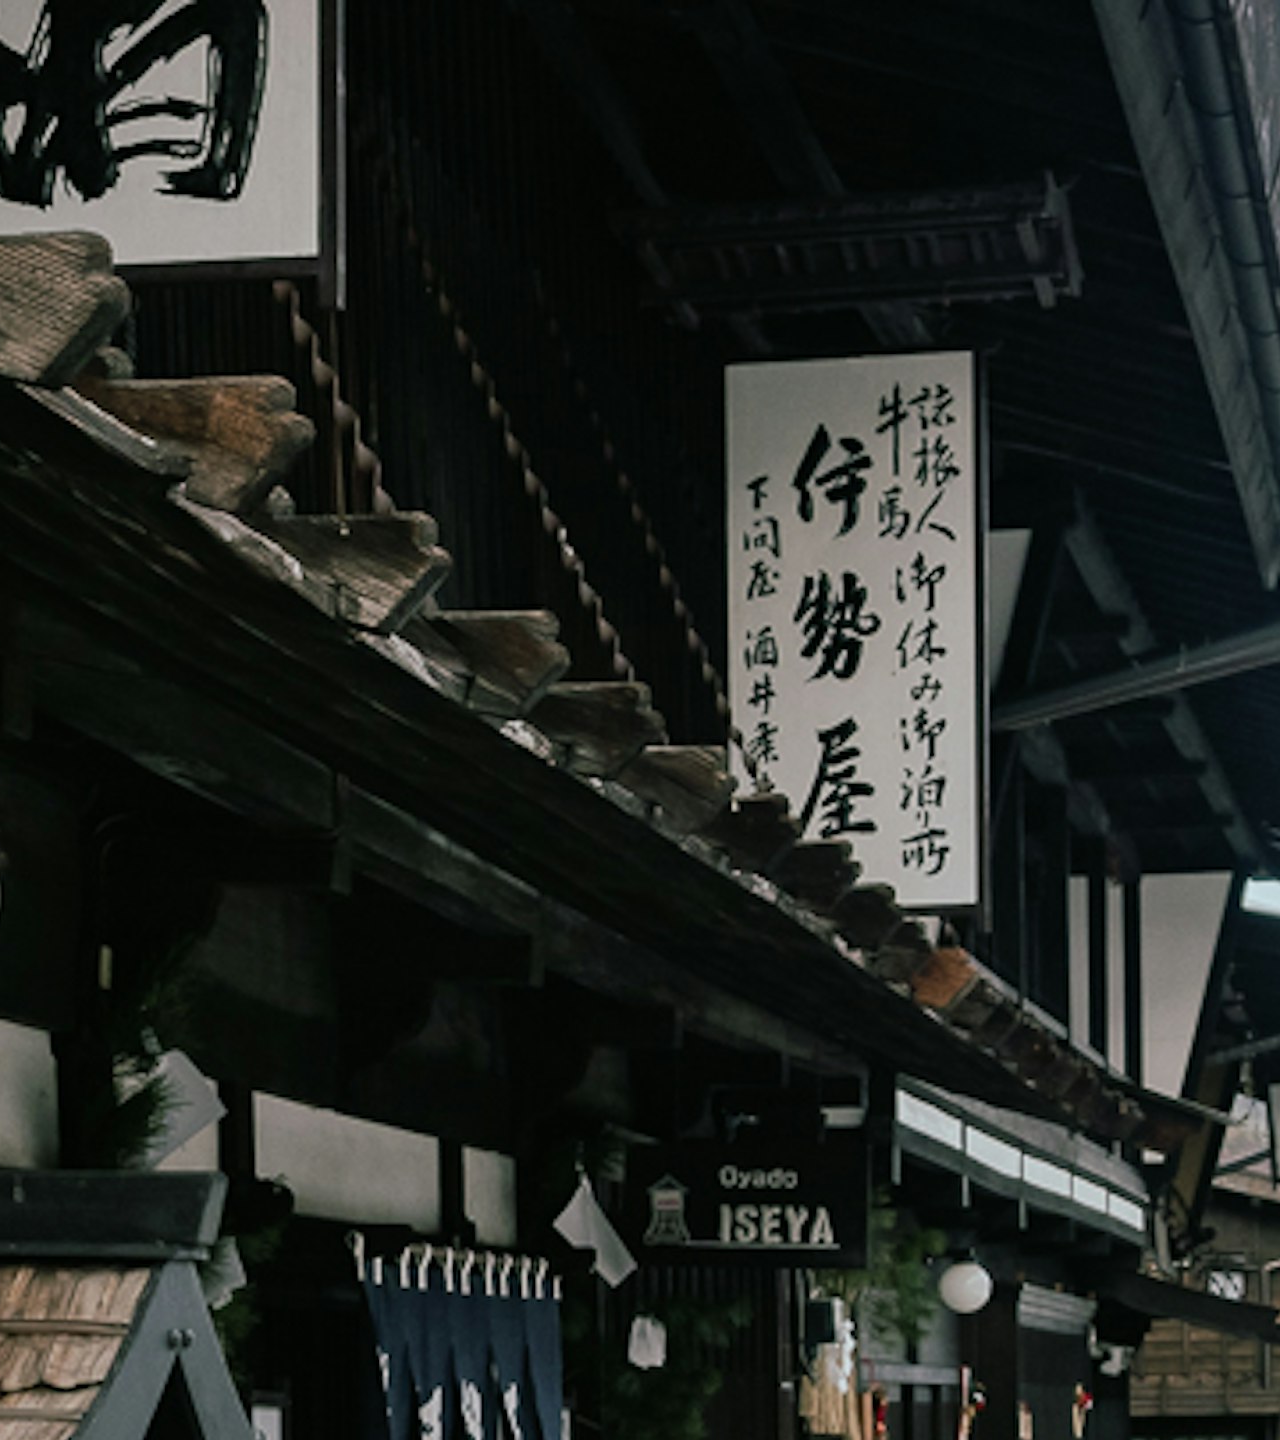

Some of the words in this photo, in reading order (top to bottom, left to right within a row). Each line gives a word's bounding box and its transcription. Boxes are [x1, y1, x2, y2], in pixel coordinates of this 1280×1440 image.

[792, 422, 882, 840] 伊勢屋
[718, 1164, 800, 1190] Oyado
[718, 1203, 835, 1243] ISEYA
